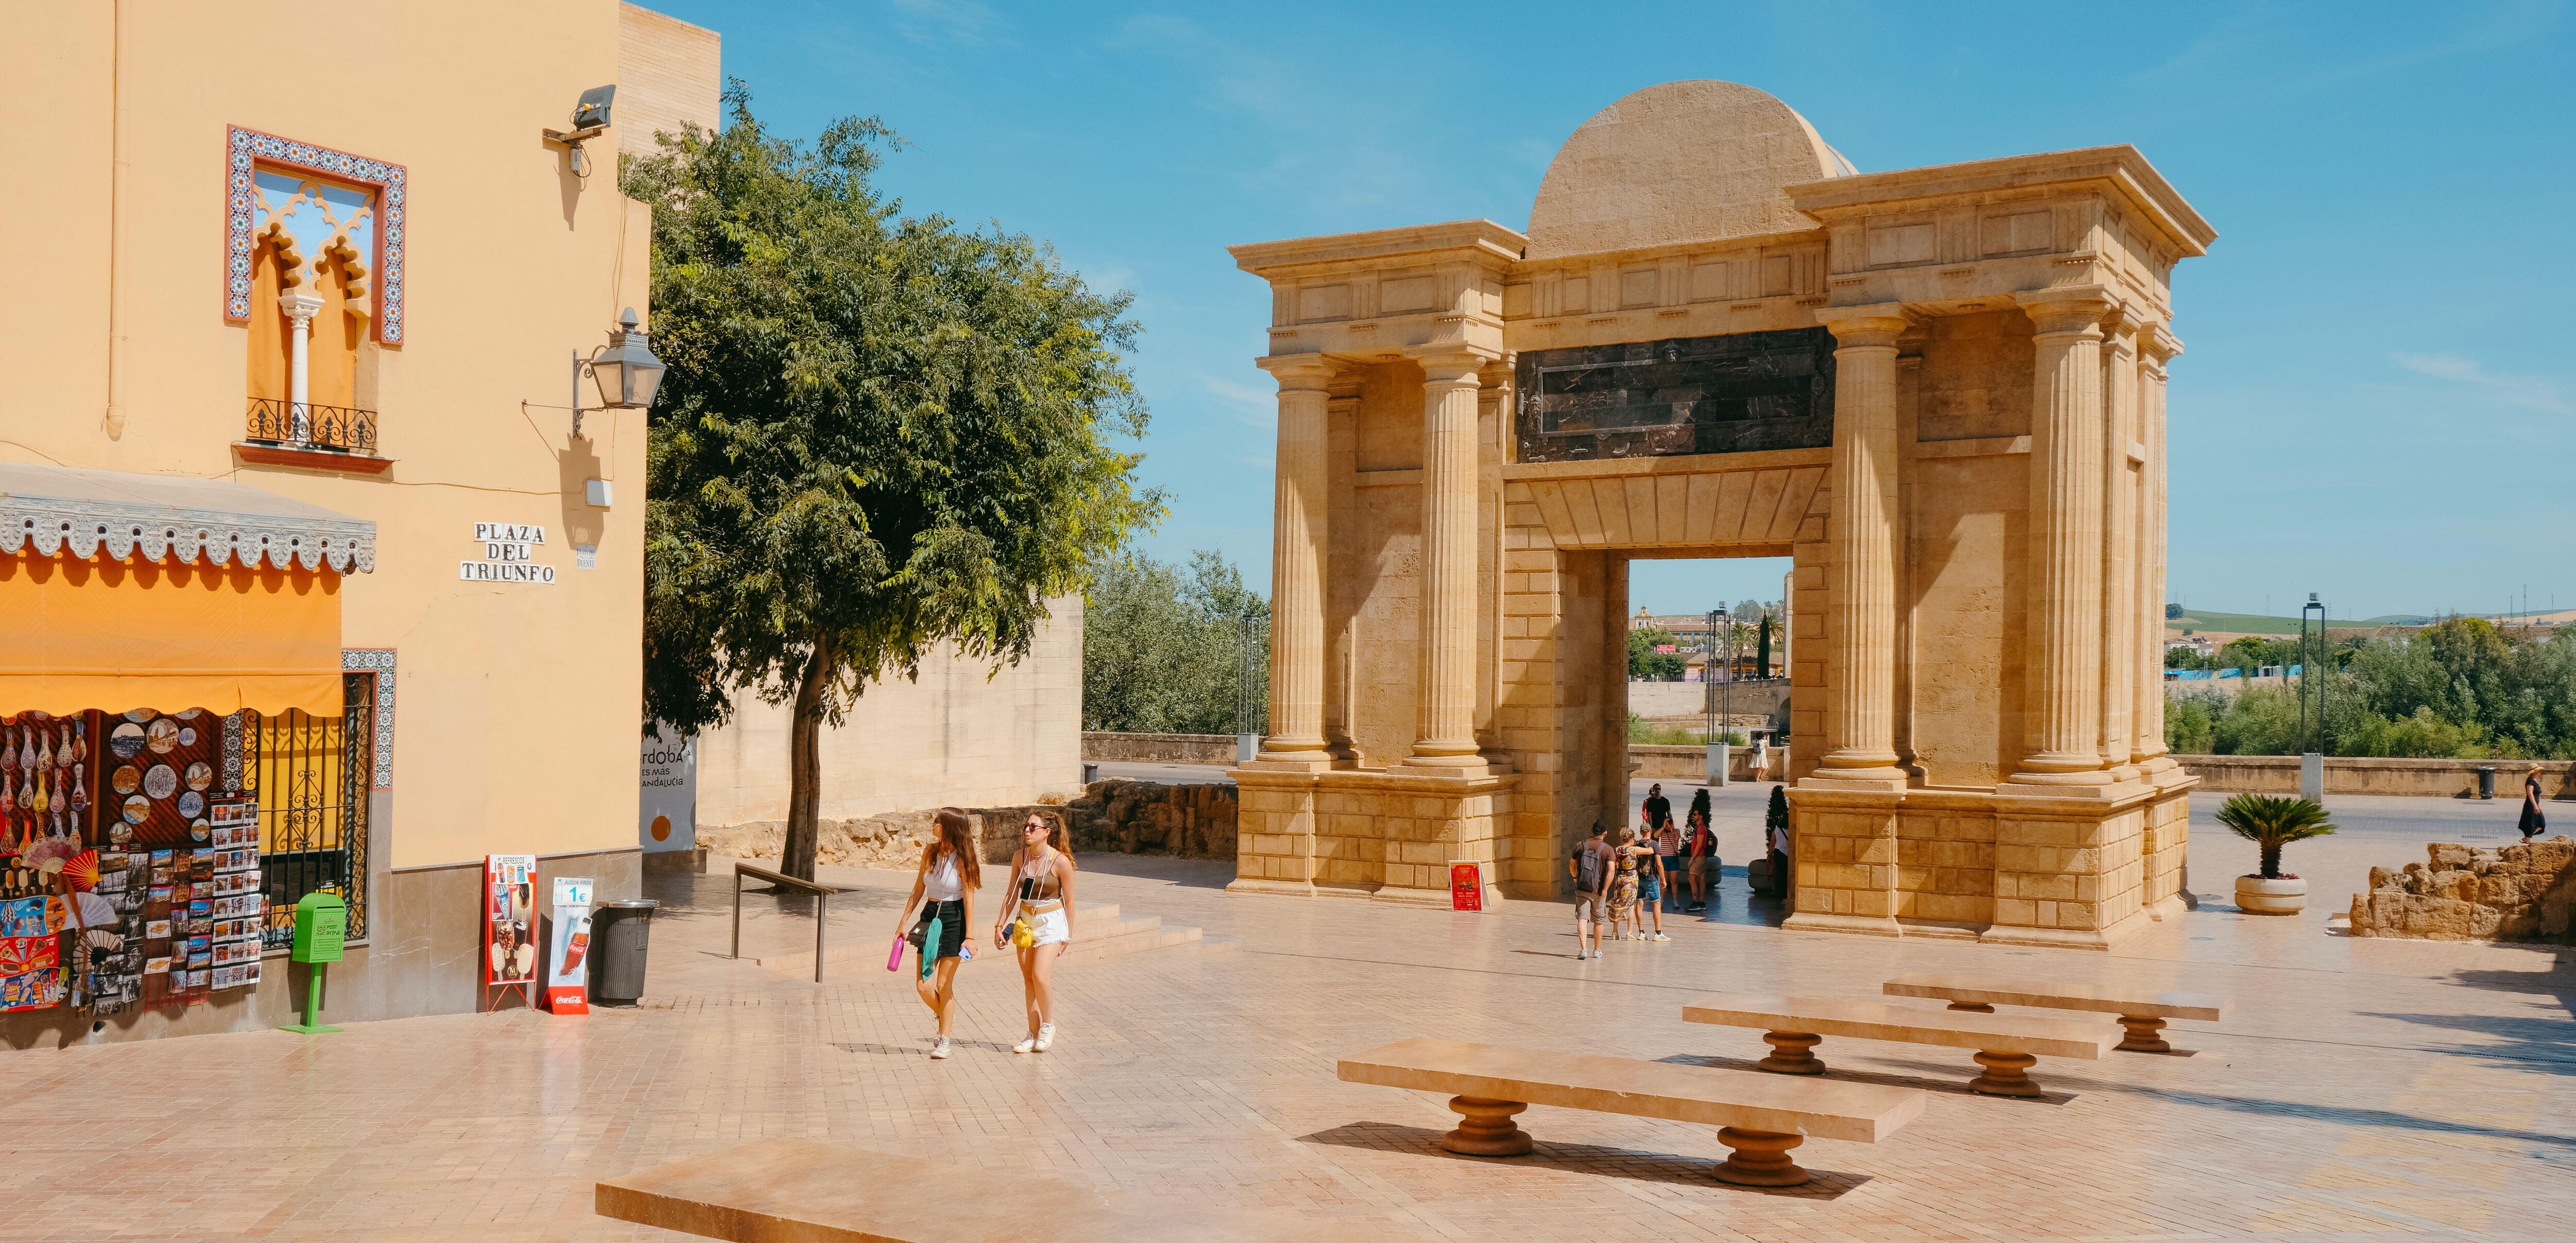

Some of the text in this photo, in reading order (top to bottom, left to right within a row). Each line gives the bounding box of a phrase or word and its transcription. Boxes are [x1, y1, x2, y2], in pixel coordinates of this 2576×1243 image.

[476, 523, 543, 542] PLAZA
[488, 543, 529, 560] DEL
[462, 563, 554, 582] TRIUNFO
[577, 559, 595, 568] PUENTE
[642, 744, 683, 764] rdobA
[556, 996, 582, 1004] Coca-Cola
